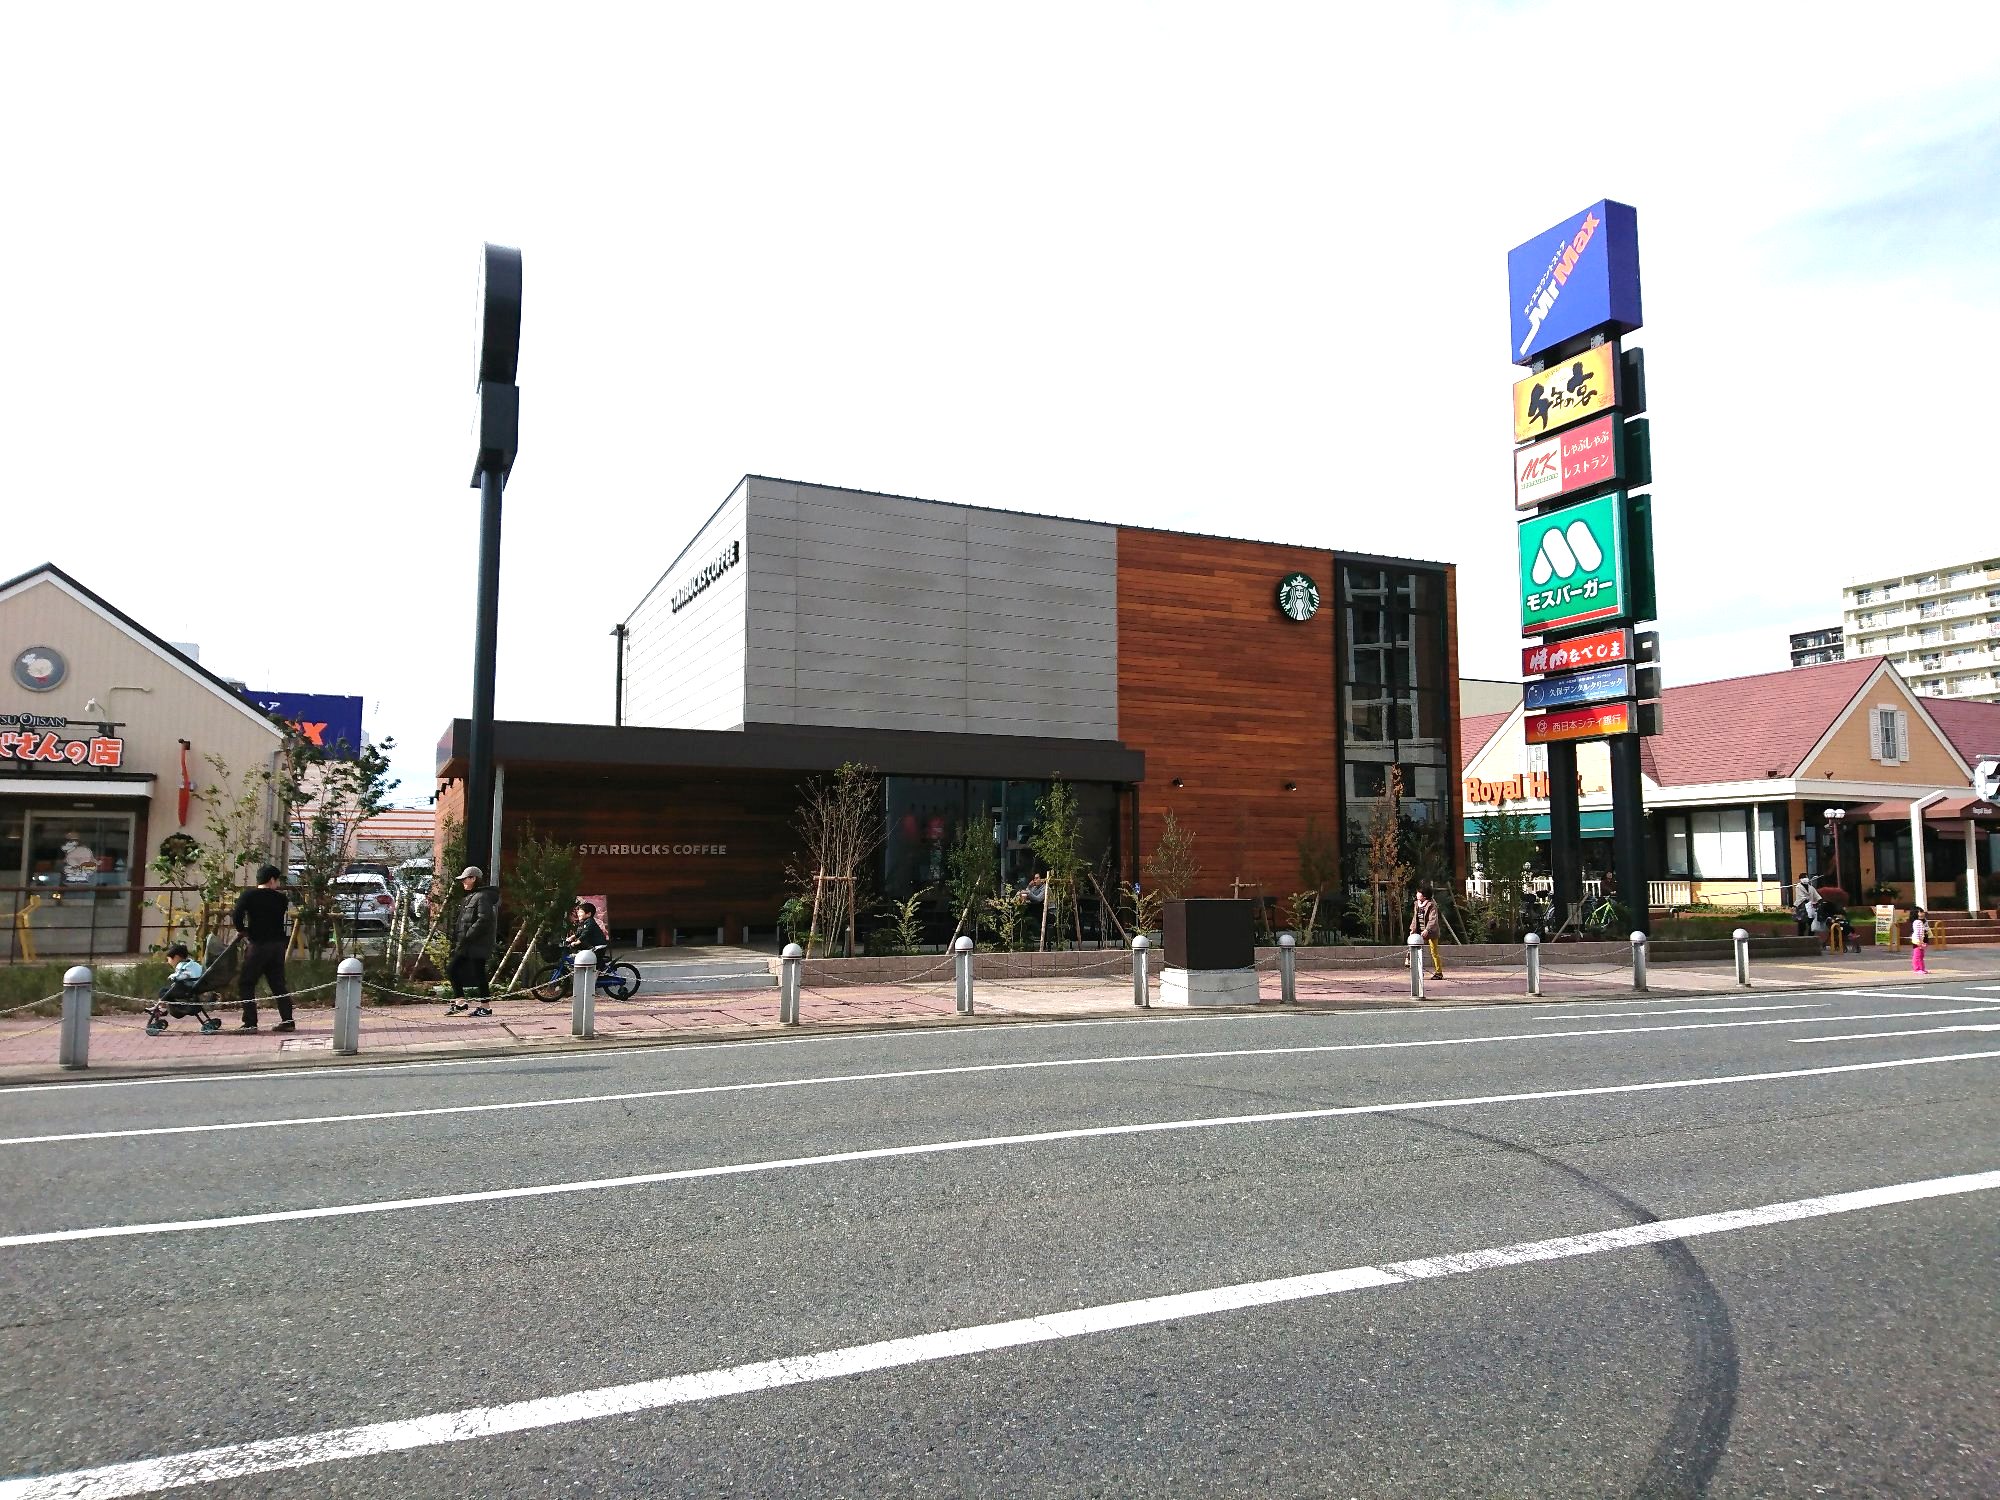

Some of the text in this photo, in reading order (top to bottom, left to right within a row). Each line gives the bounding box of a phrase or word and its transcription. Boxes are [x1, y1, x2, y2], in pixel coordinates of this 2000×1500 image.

[1563, 431, 1610, 457] しゃぶしゃぶ
[1564, 454, 1609, 479] レストラン
[1526, 577, 1613, 611] モスバーガー
[1549, 677, 1623, 698] 久保デンタルクリニック
[0, 715, 17, 725] SU
[1552, 713, 1622, 732] 西日本シティ銀行
[1463, 773, 1524, 806] Royal
[578, 844, 727, 855] STARBUCKS COFFEE
